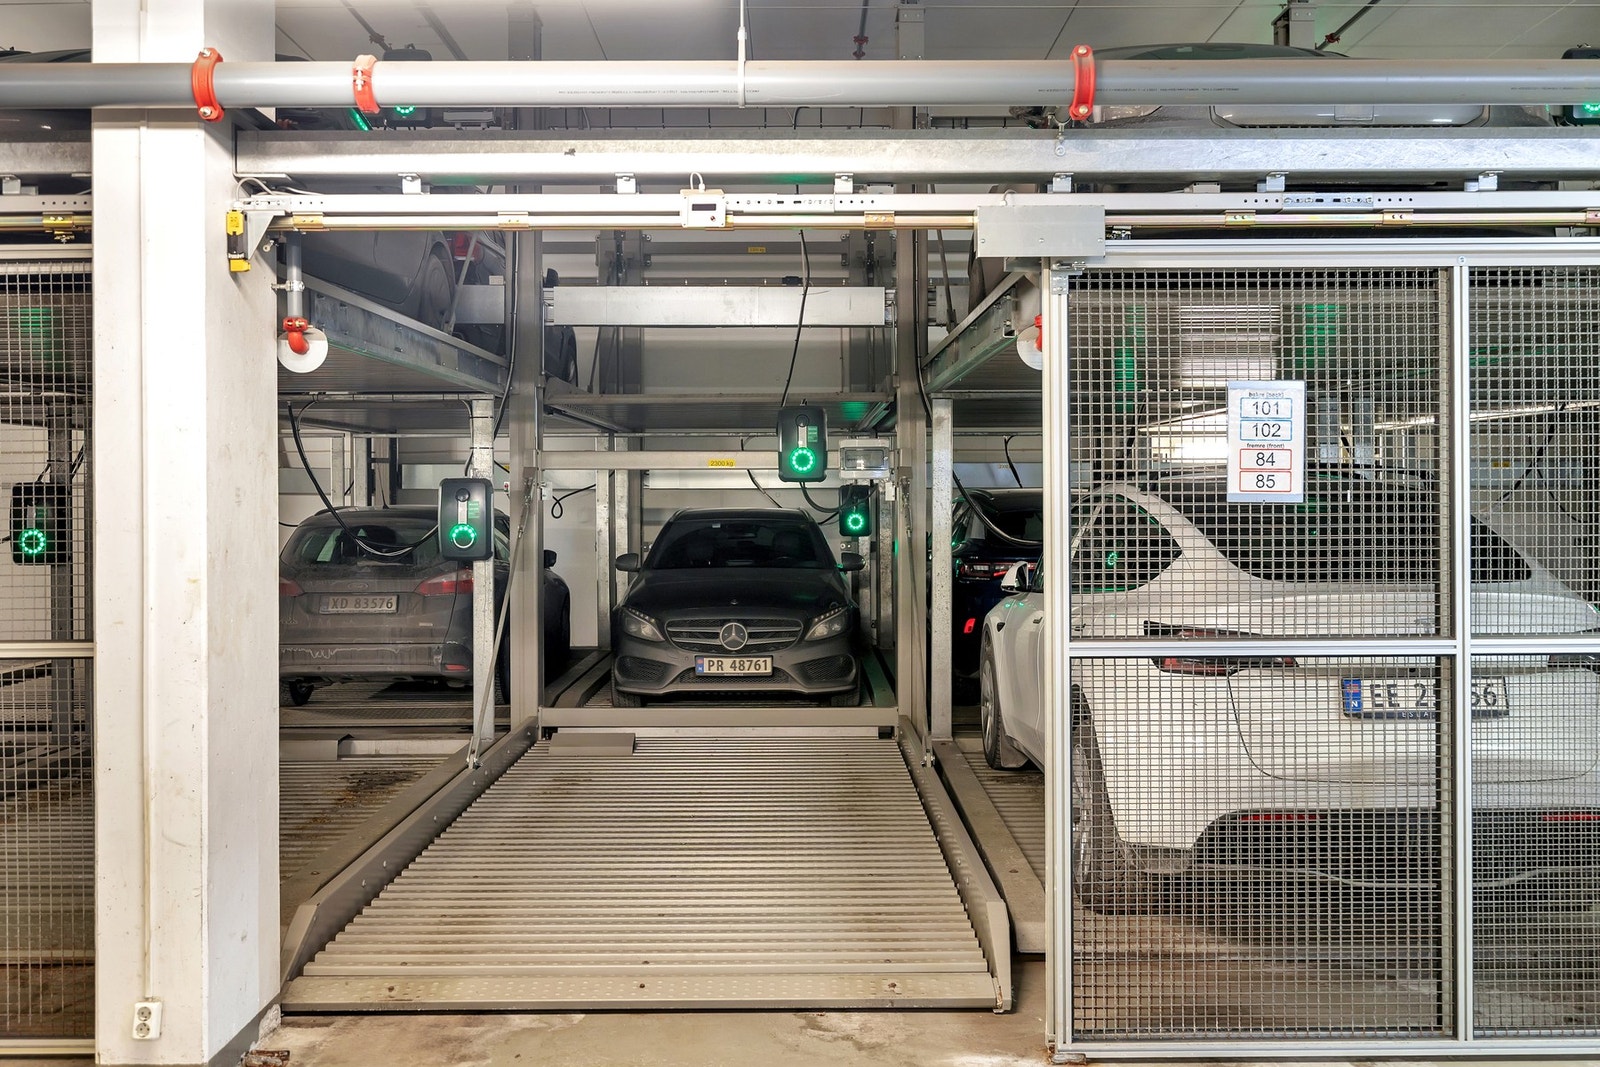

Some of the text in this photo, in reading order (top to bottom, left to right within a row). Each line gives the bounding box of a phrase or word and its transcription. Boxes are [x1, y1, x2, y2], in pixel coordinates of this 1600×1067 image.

[1252, 401, 1279, 415] 101
[1252, 423, 1281, 437] 102
[1255, 452, 1275, 466] 84
[1255, 474, 1275, 488] 85
[331, 598, 393, 609] XD 83576
[707, 660, 724, 671] PR
[730, 659, 768, 671] 48761
[1370, 684, 1399, 707] EE
